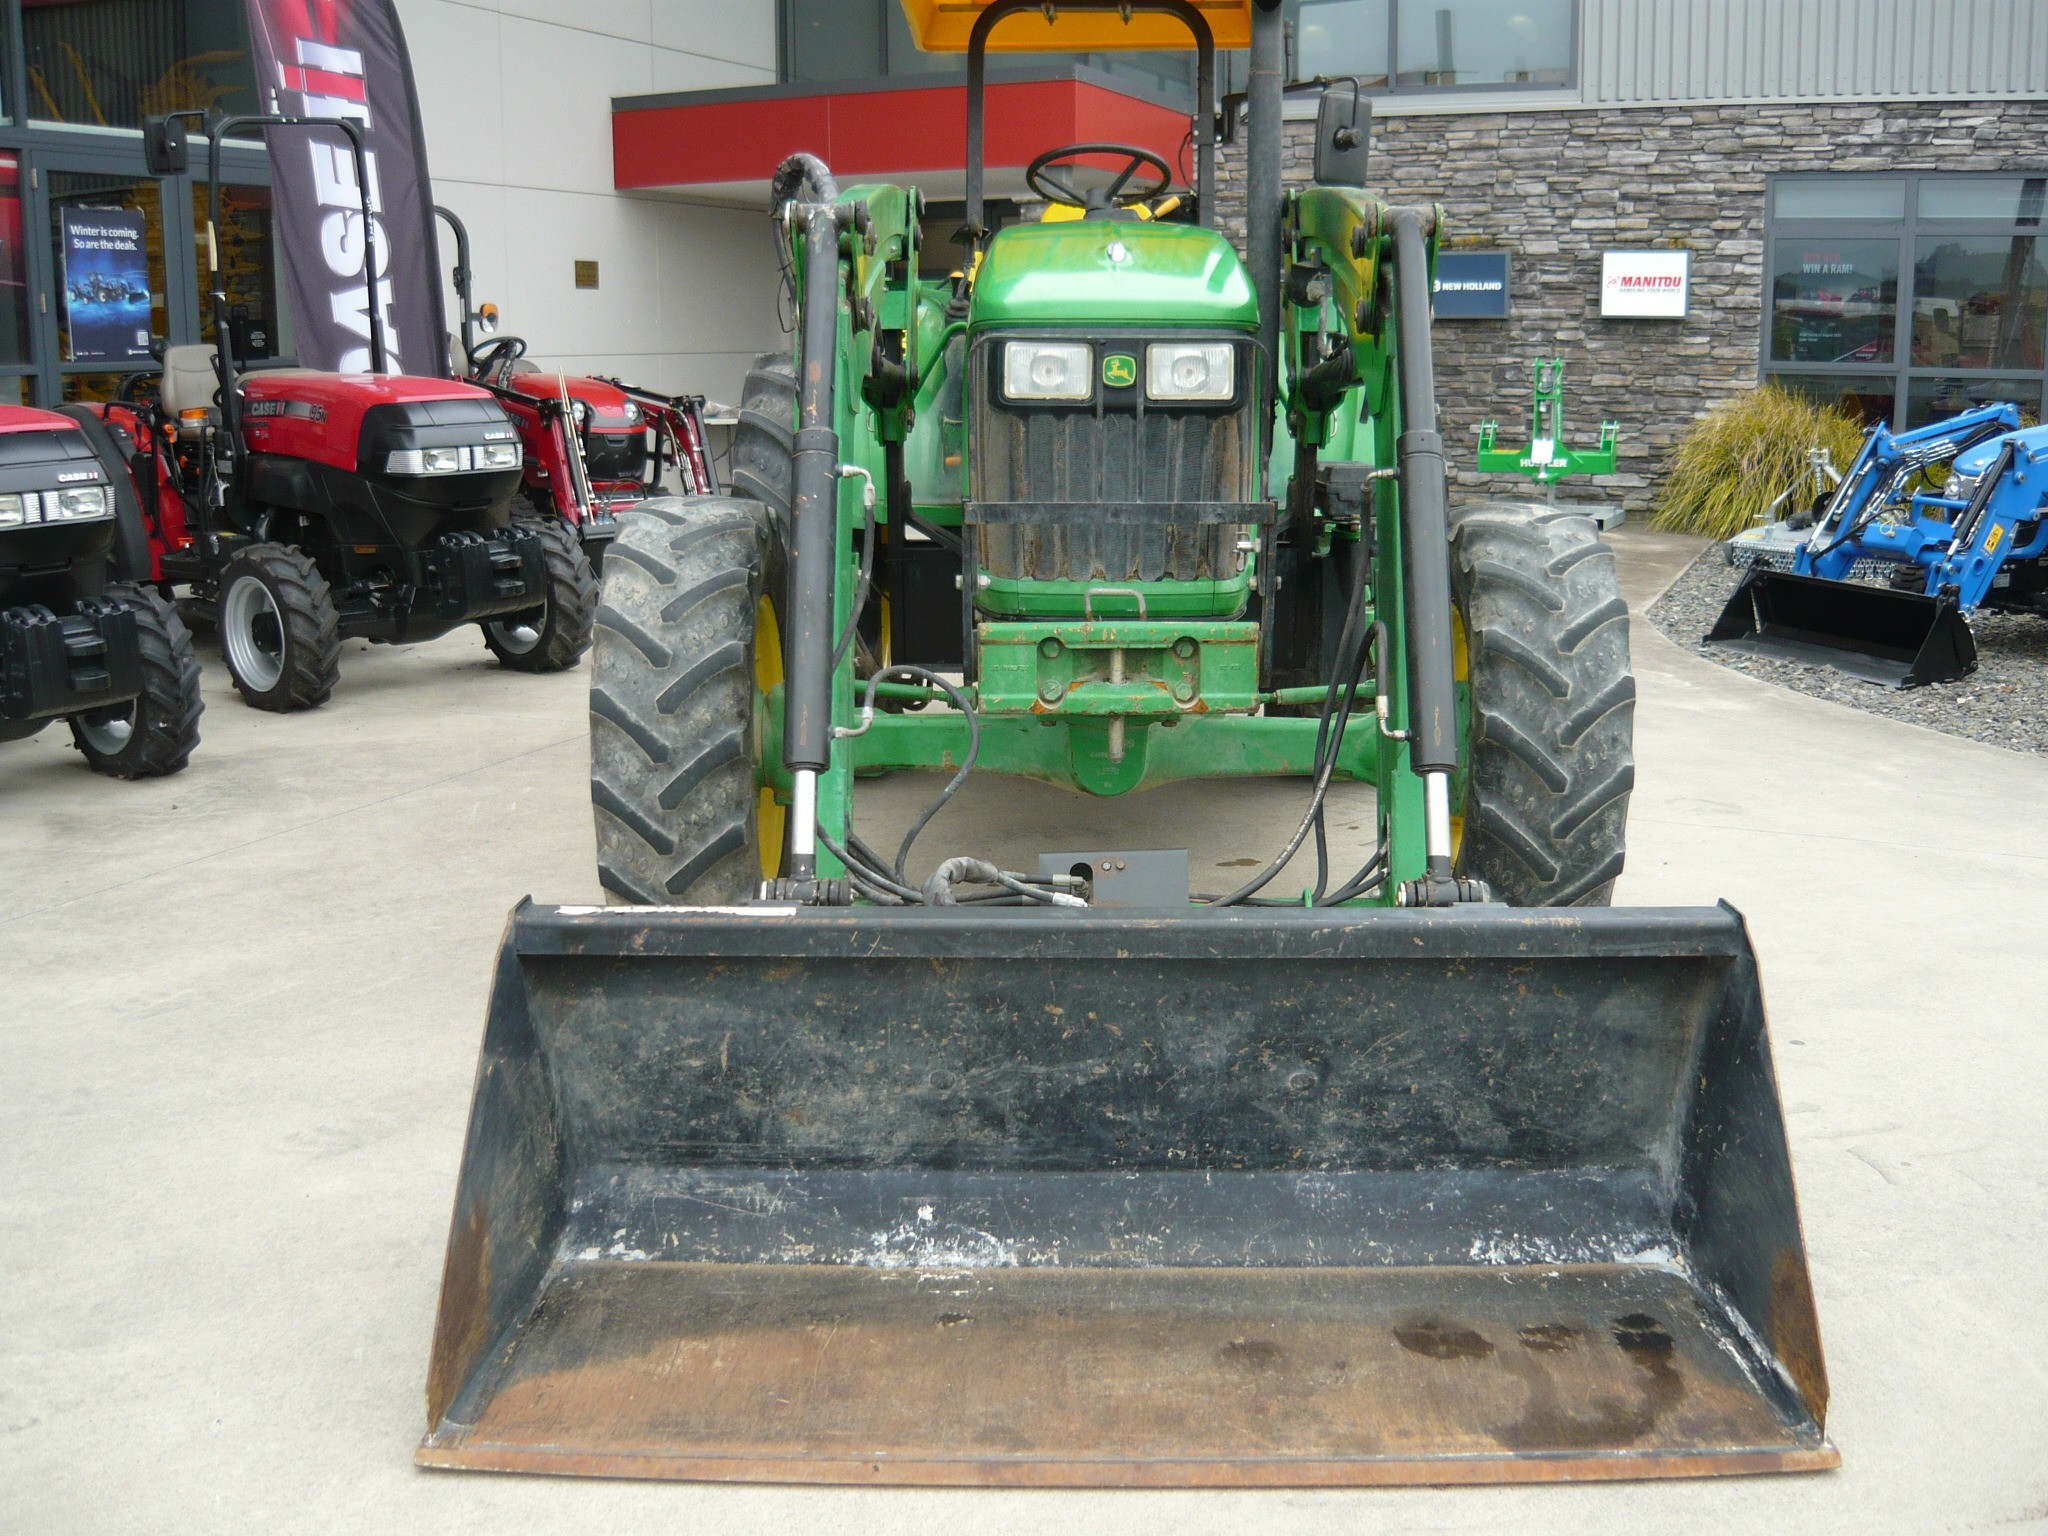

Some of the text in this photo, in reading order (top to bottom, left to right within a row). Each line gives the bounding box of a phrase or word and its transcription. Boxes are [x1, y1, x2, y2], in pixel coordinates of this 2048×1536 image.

[70, 225, 139, 240] Winter is coming.
[74, 239, 138, 251] So are the deals.
[1803, 263, 1853, 274] WIN A RAM!
[1442, 282, 1502, 291] NEW HOLLAND
[1620, 276, 1682, 287] MANITOU
[252, 402, 276, 416] CASE
[1520, 458, 1568, 467] HULER
[58, 472, 88, 482] CASE
